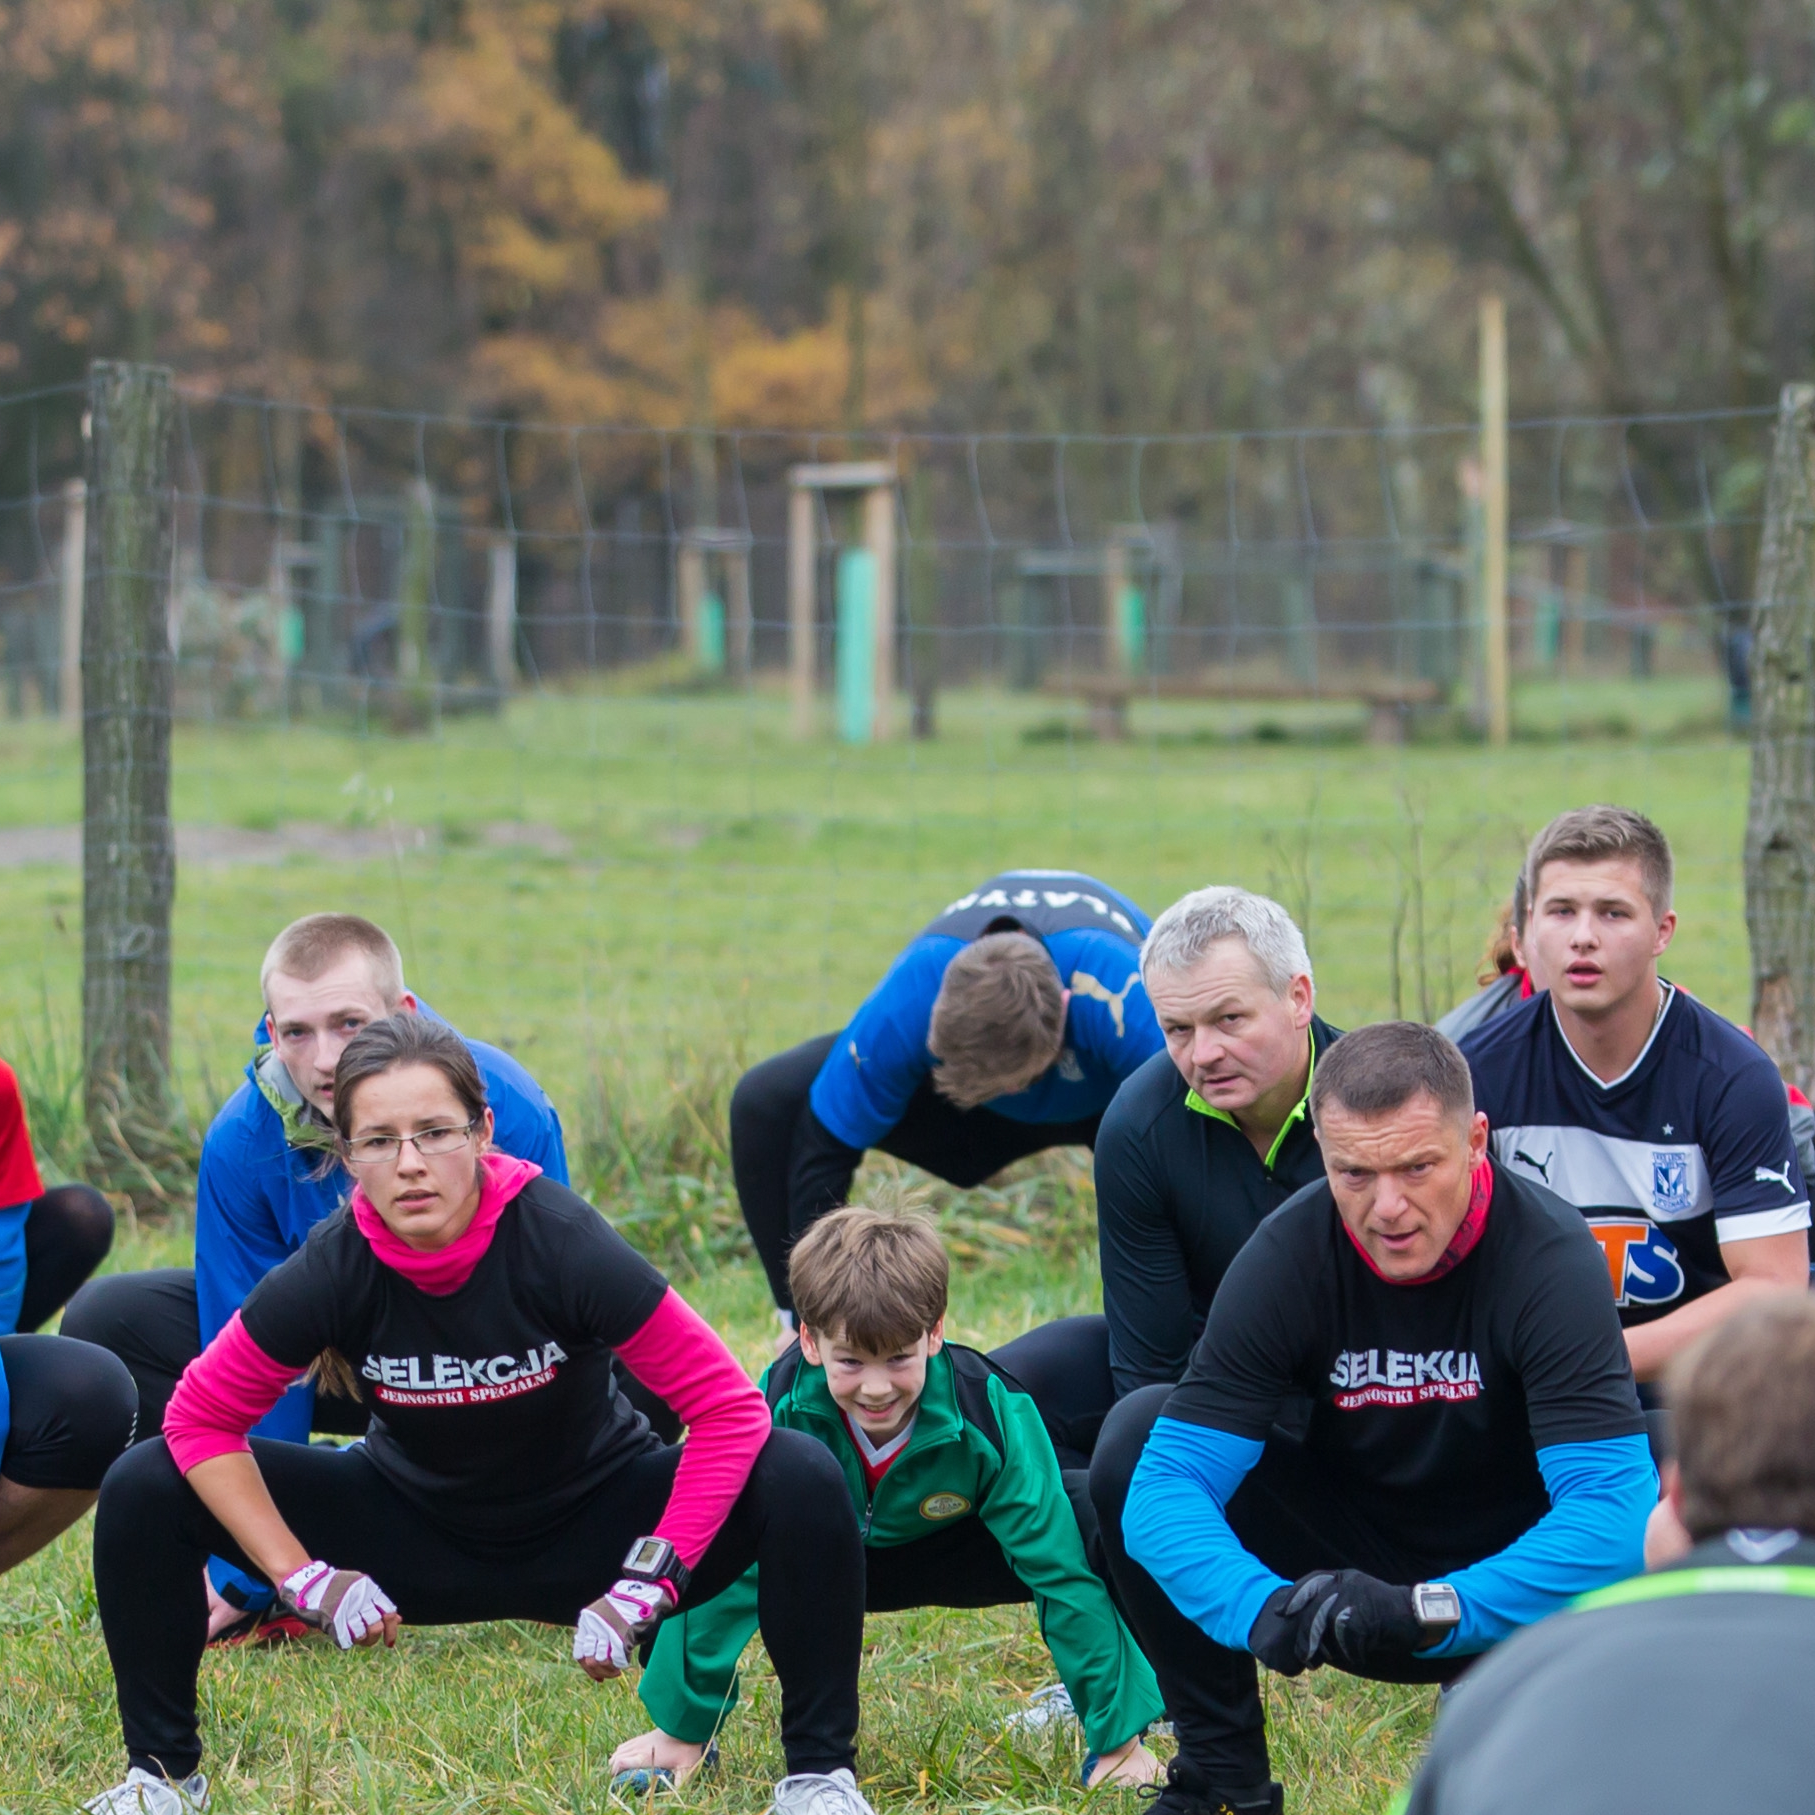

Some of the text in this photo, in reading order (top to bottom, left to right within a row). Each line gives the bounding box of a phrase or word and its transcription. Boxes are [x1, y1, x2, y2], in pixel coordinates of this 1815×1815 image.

[361, 1340, 569, 1390] SELEKCJA
[380, 1368, 555, 1405] JEDNOSTKI SPECJALNE
[1339, 1388, 1414, 1408] JEDNOSTKI
